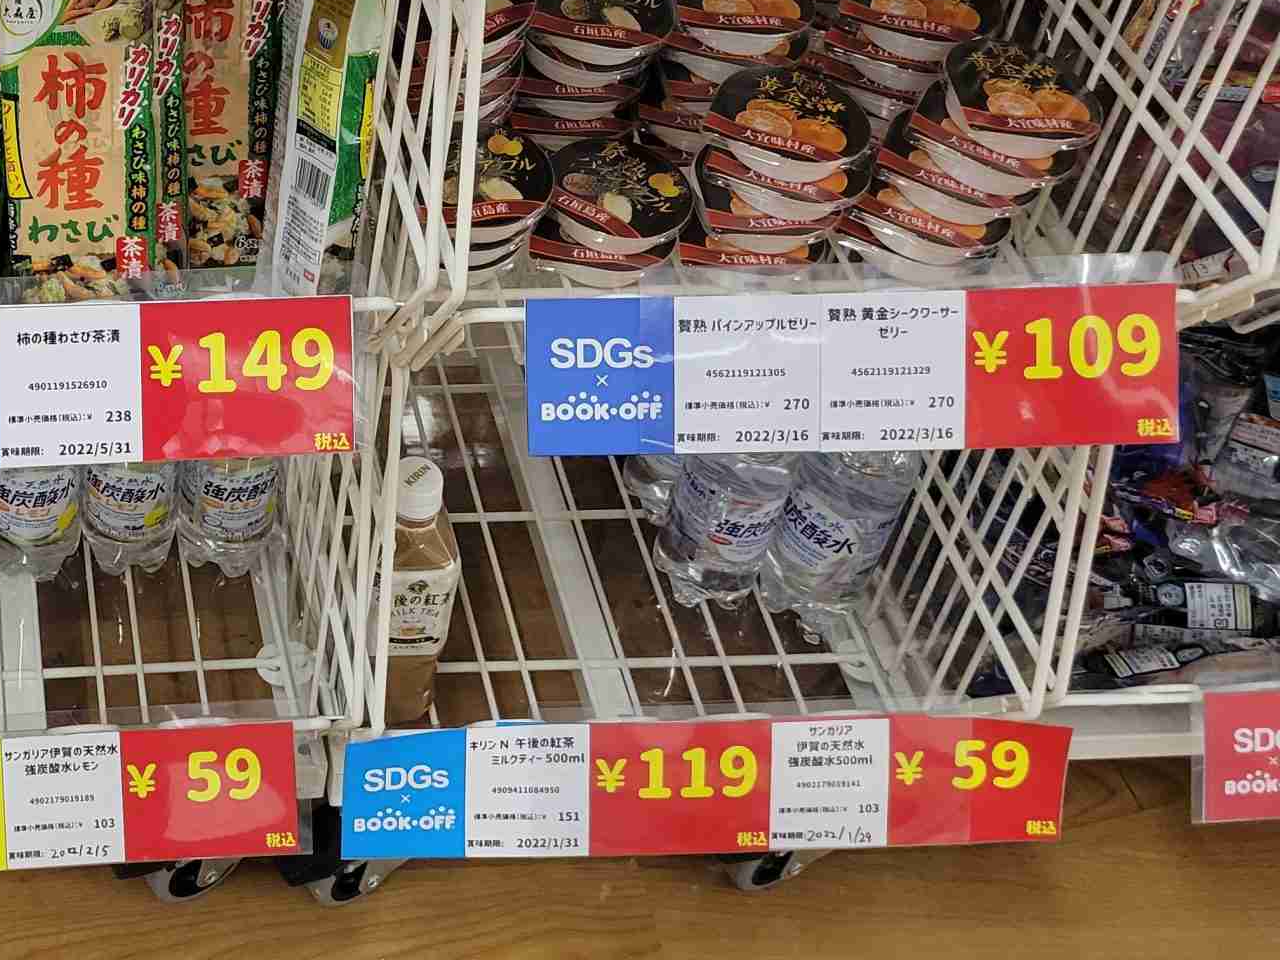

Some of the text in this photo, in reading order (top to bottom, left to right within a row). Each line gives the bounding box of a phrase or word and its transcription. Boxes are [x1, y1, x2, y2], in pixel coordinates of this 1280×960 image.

[34, 52, 109, 211] 柿の種
[29, 213, 121, 244] わさび
[878, 326, 909, 339] ゼリー
[550, 337, 655, 370] SDGs
[783, 398, 810, 412] 270
[928, 395, 955, 409] 270
[105, 409, 132, 424] 238
[880, 427, 954, 441] 2022/3/16
[1137, 418, 1174, 437] 税込
[314, 432, 351, 451] 税込
[735, 429, 809, 444] 2022/3/16
[59, 441, 132, 457] 2022/5/31
[364, 764, 450, 792] SDGs
[858, 803, 880, 814] 103
[94, 818, 115, 829] 103
[558, 811, 580, 822] 151
[516, 837, 580, 849] 2022/1/31
